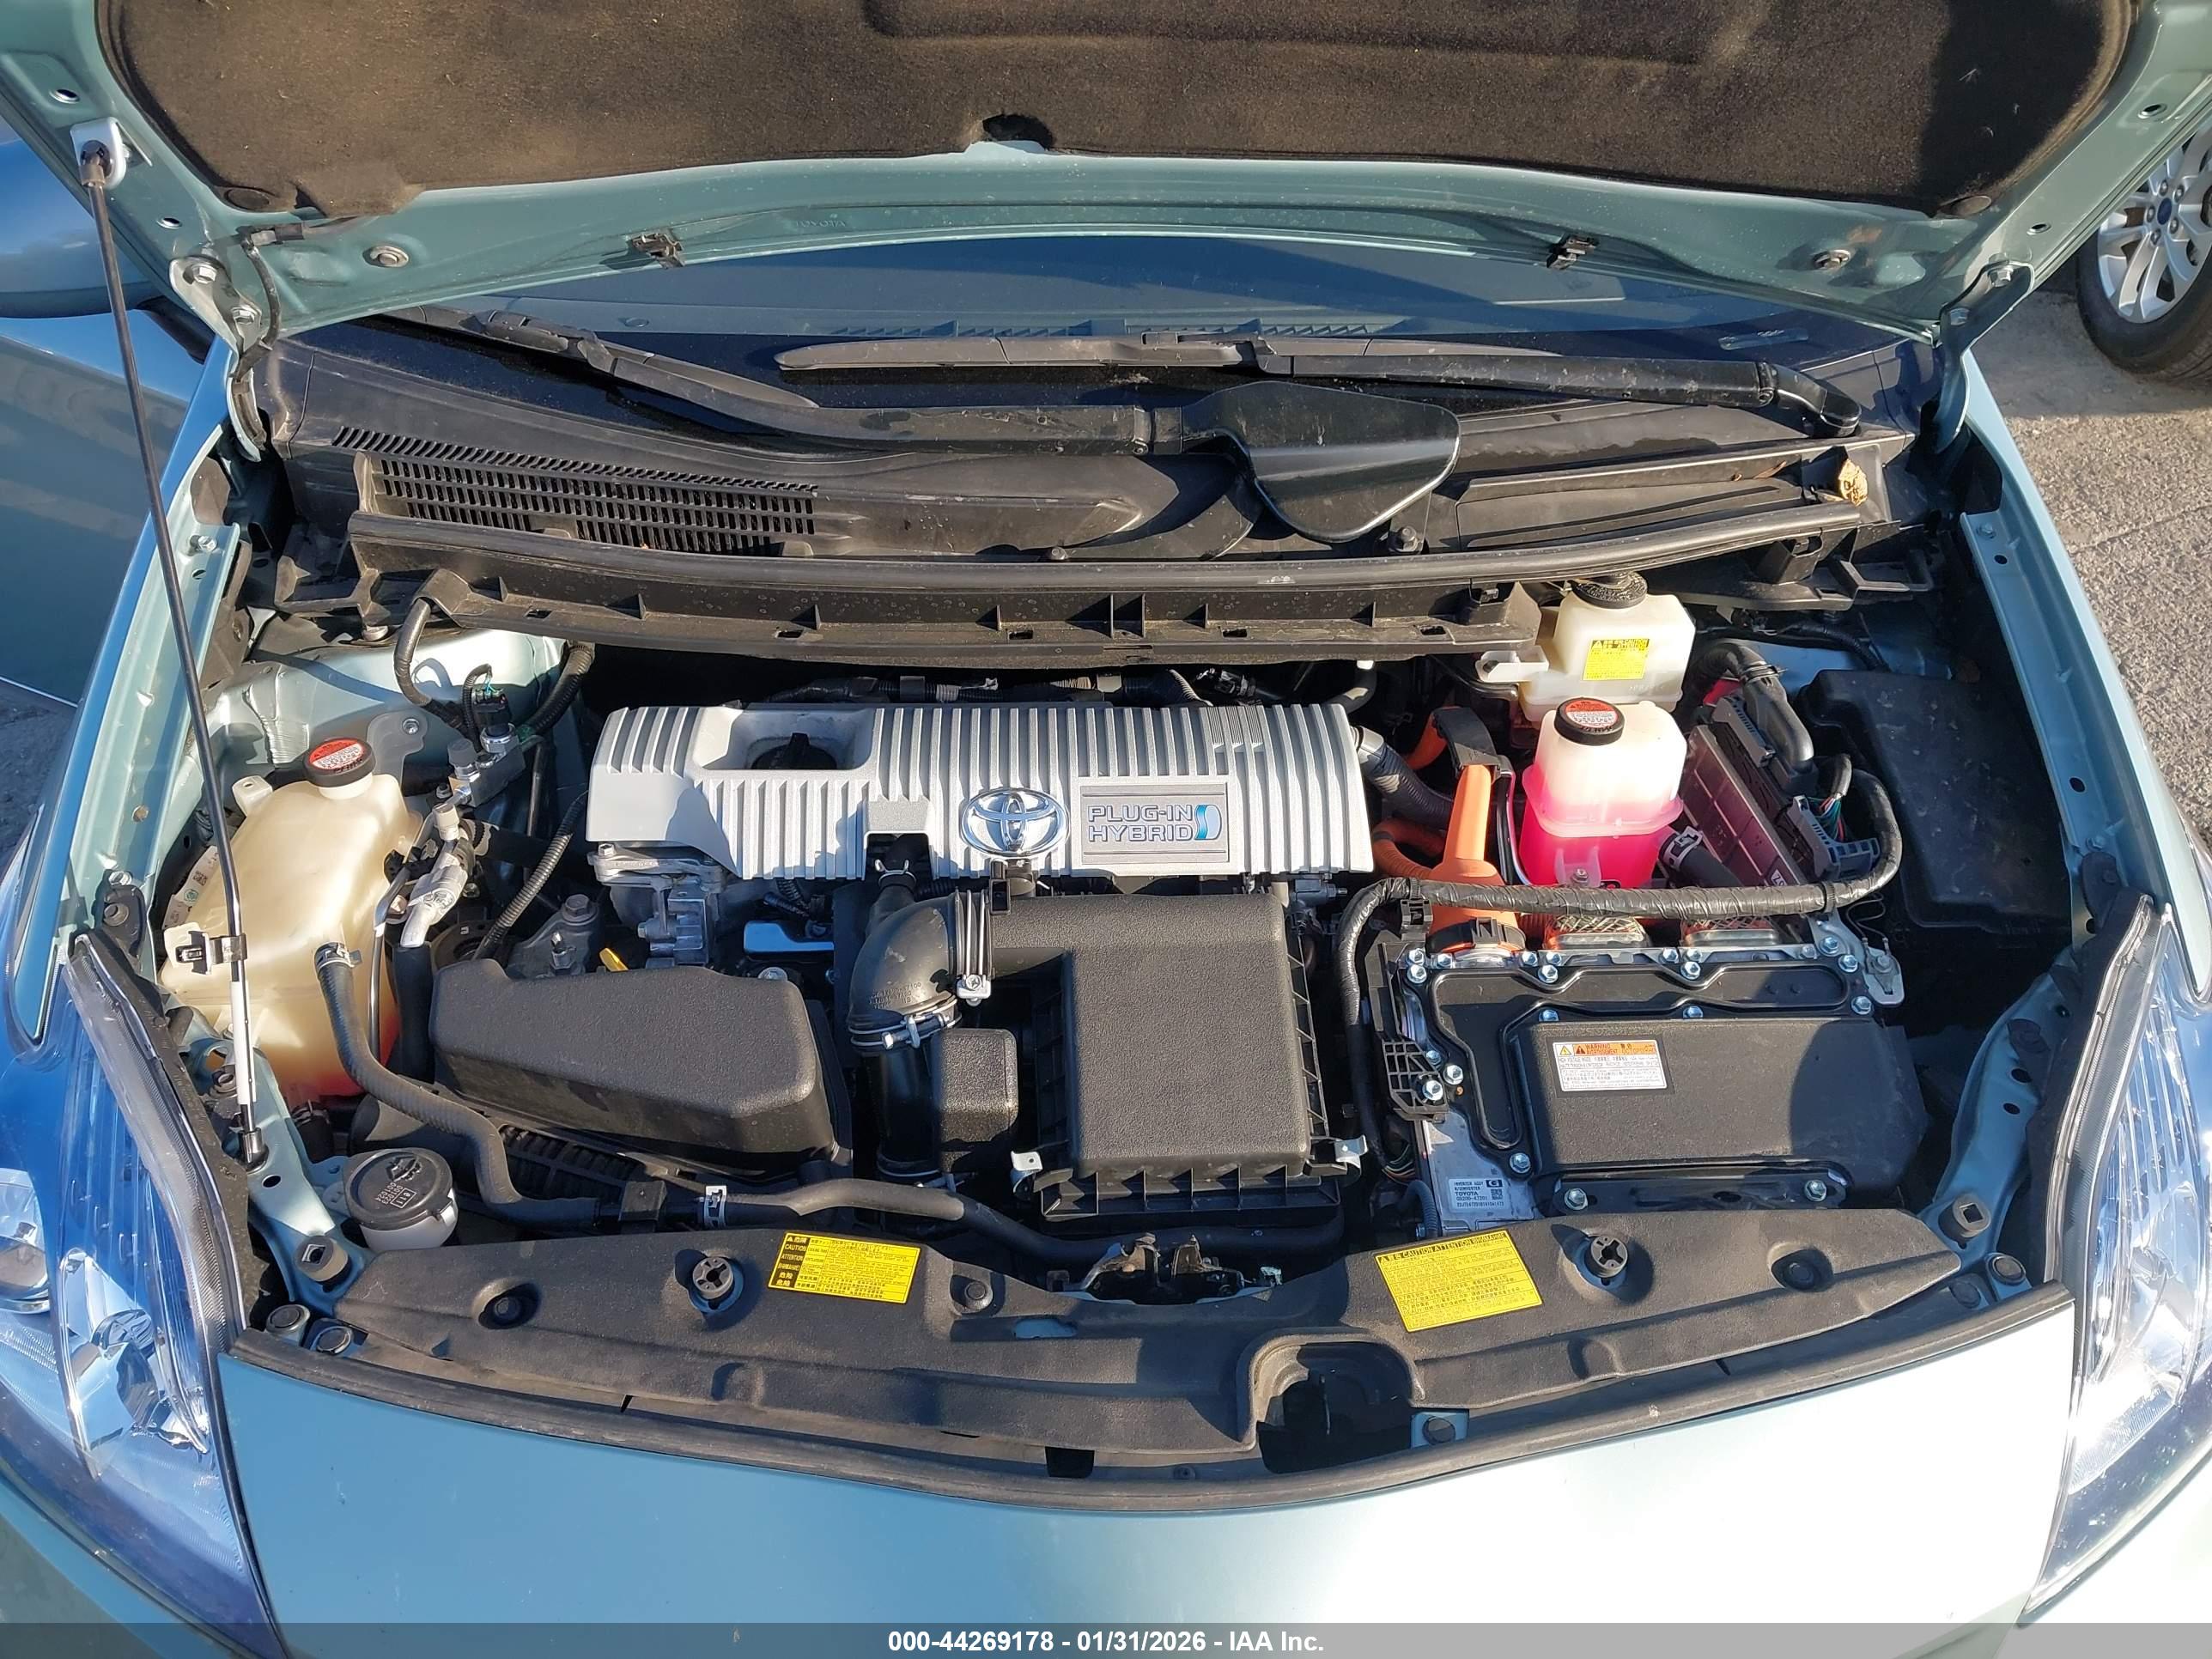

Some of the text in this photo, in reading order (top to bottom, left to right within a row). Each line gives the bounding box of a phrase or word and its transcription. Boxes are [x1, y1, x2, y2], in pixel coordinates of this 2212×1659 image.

[1087, 804, 1193, 822] PLUG-IN
[1088, 823, 1193, 842] HYBRID
[375, 1182, 397, 1202] 001024
[381, 1185, 404, 1205] 001023
[785, 1243, 807, 1252] CAUTION
[1403, 1247, 1432, 1257] CAUTION
[1435, 1239, 1472, 1252] ATTENTION
[781, 1253, 804, 1261] ATTENTION
